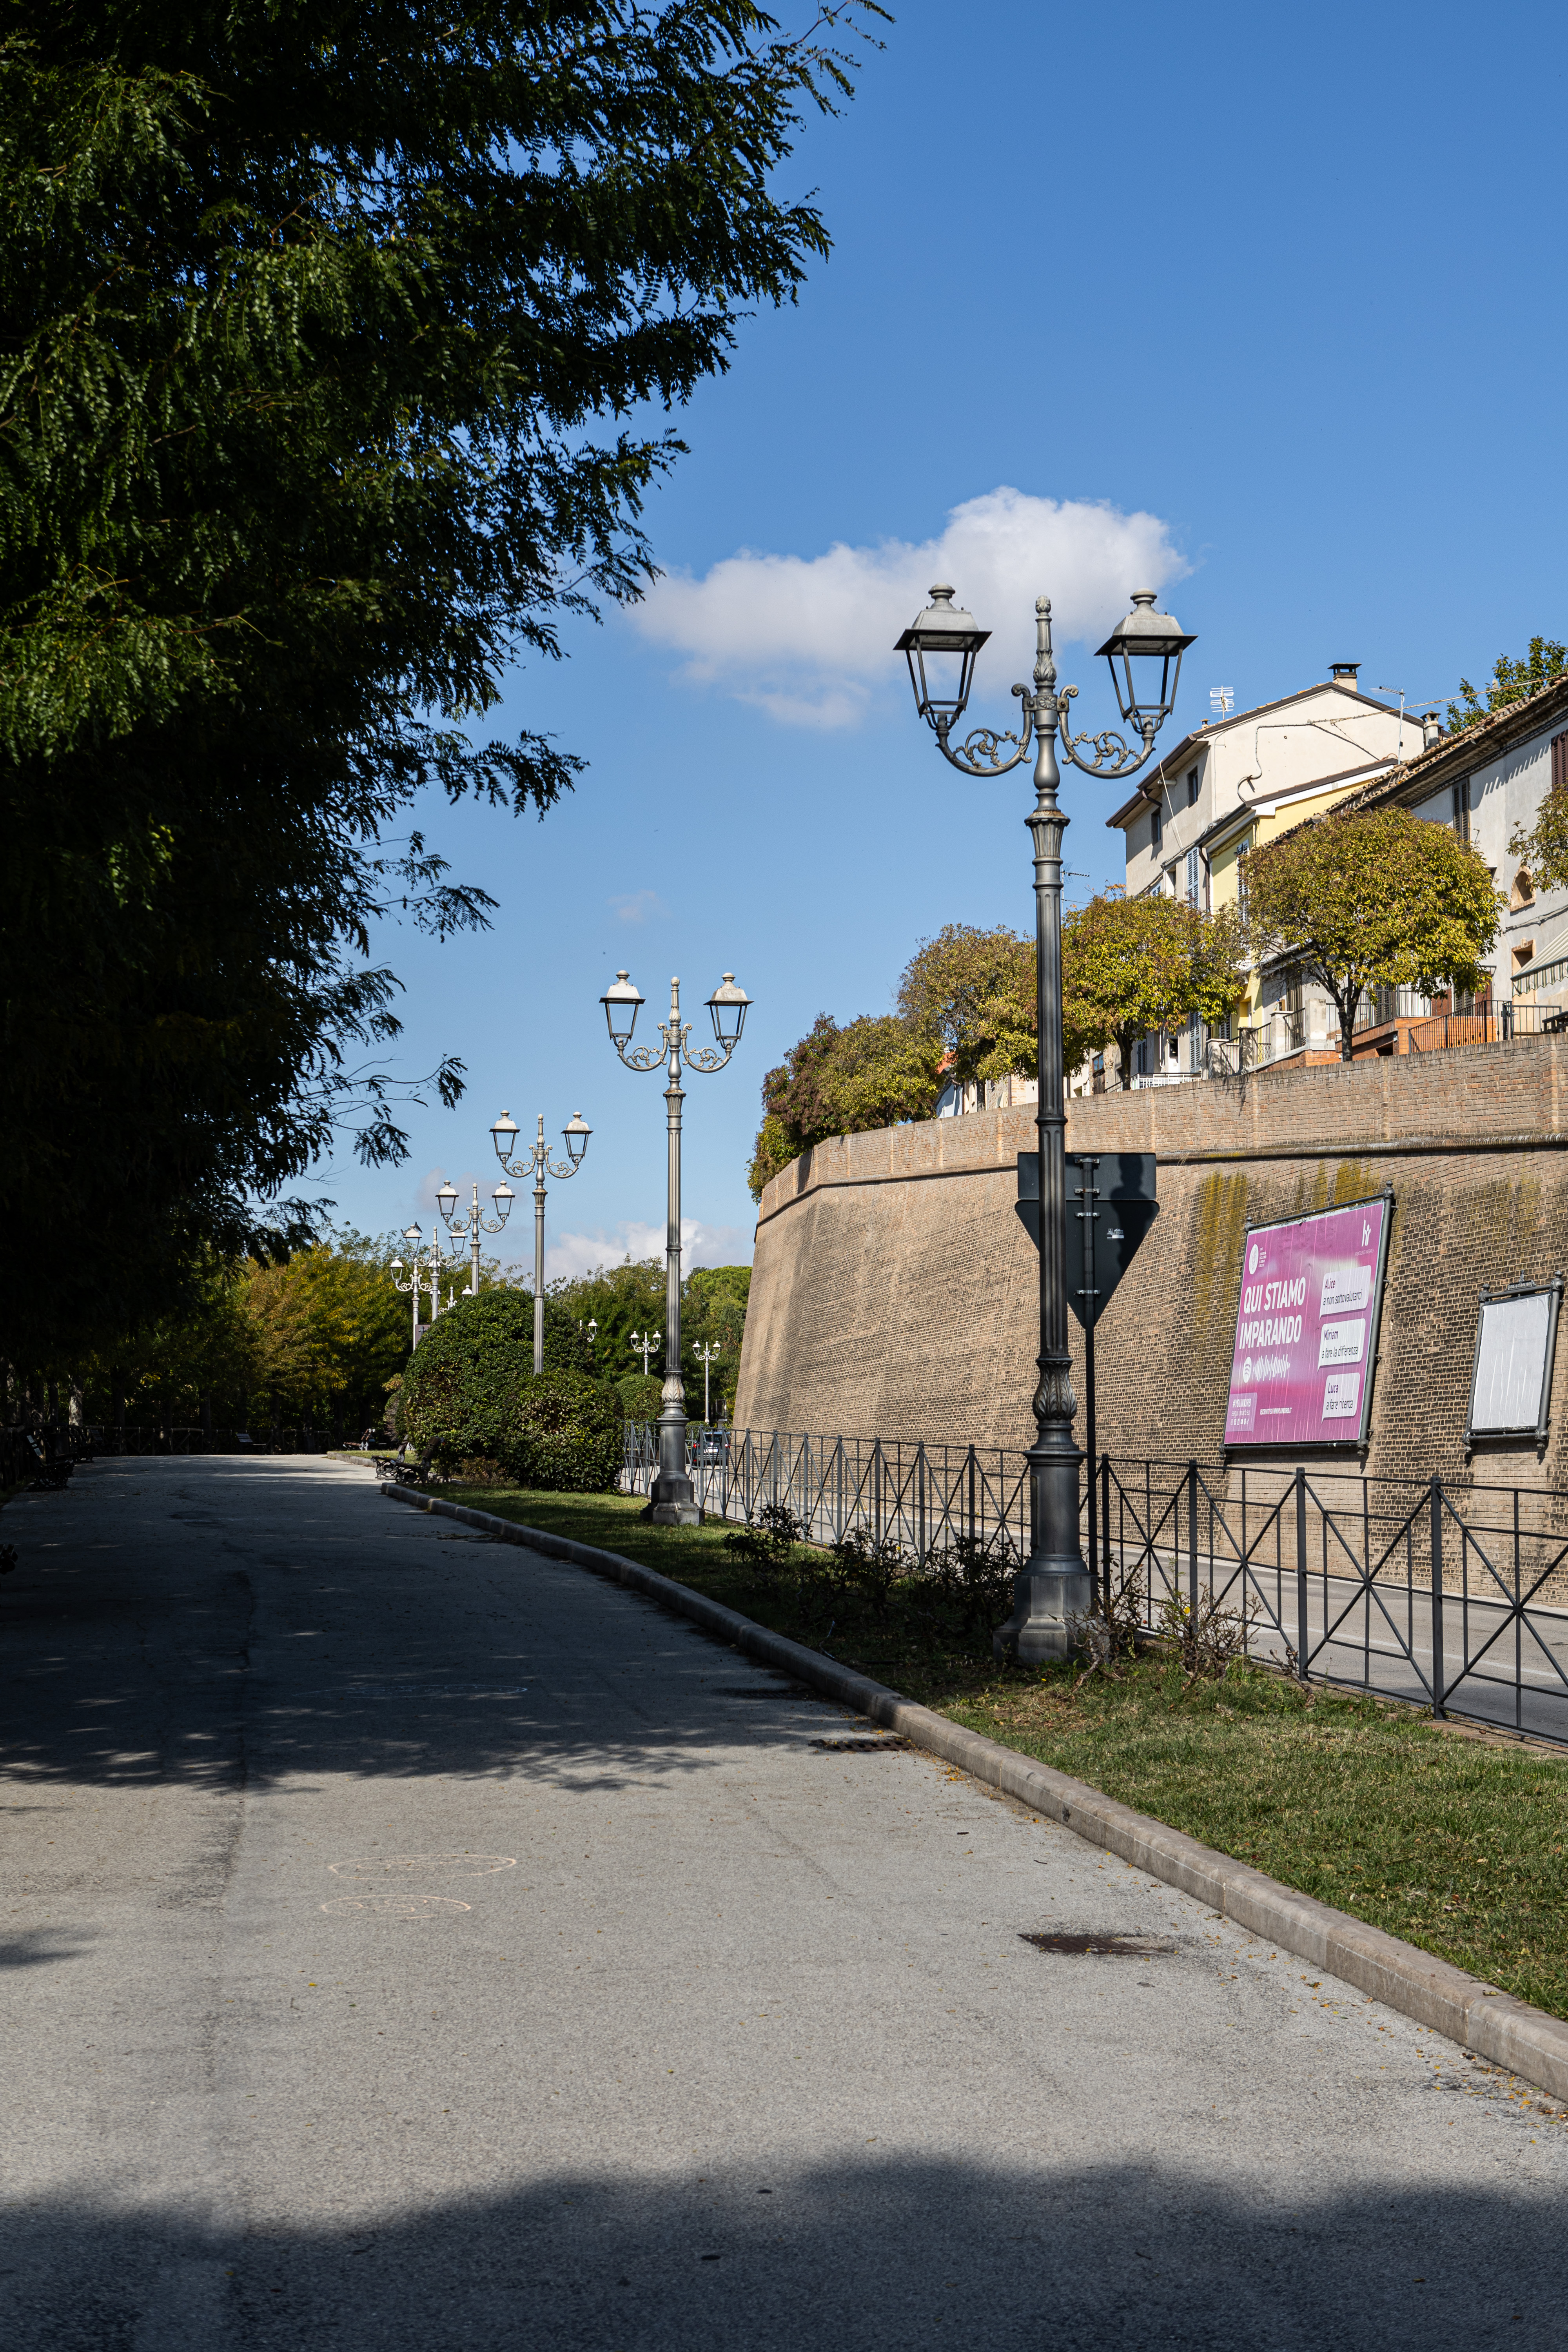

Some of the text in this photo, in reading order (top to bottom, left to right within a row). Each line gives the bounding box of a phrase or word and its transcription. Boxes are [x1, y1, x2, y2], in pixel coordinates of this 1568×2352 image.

[1325, 1278, 1336, 1290] Alice
[1244, 1277, 1306, 1314] QUI STIAMO
[1335, 1289, 1363, 1304] sottovalutarci
[1239, 1314, 1302, 1349] IMPARANDO
[1324, 1329, 1338, 1341] Miriam
[1333, 1347, 1337, 1357] la
[1338, 1345, 1358, 1356] differenza
[1328, 1383, 1338, 1394] Luca
[1330, 1399, 1338, 1409] fare
[1339, 1398, 1353, 1408] ricerca
